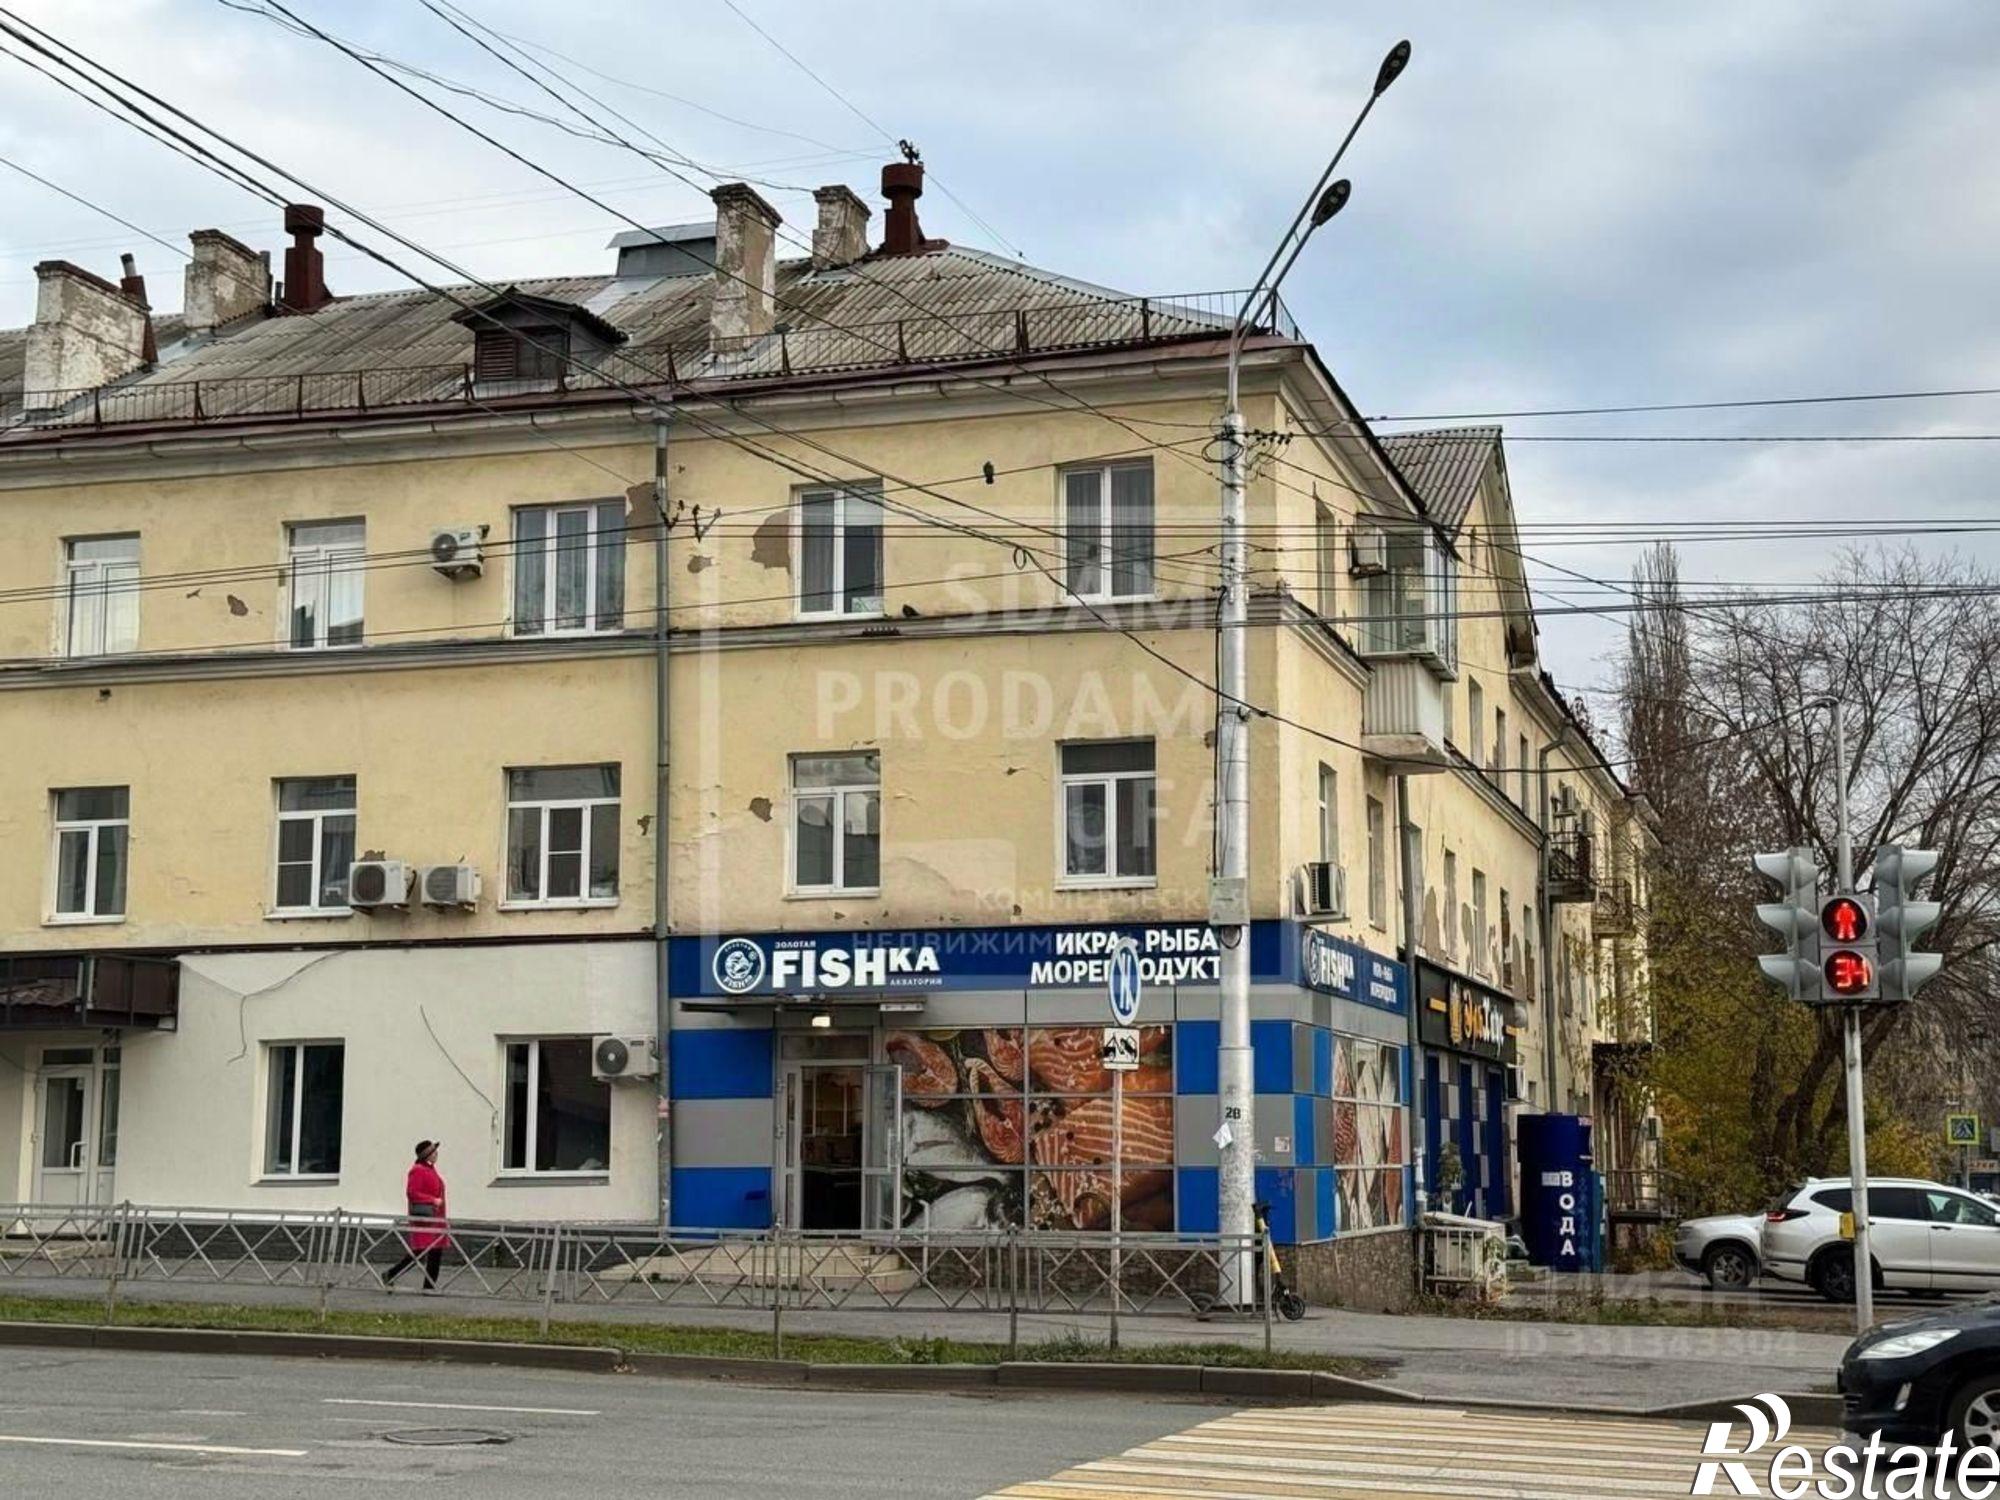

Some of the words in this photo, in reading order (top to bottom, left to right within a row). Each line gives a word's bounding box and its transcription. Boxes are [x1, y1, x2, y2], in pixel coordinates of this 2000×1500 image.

[774, 940, 817, 950] ЗОЛОТАЯ
[1055, 931, 1120, 955] ИКРА
[1145, 927, 1219, 953] РЫБА
[1558, 1170, 1576, 1256] ВОДА
